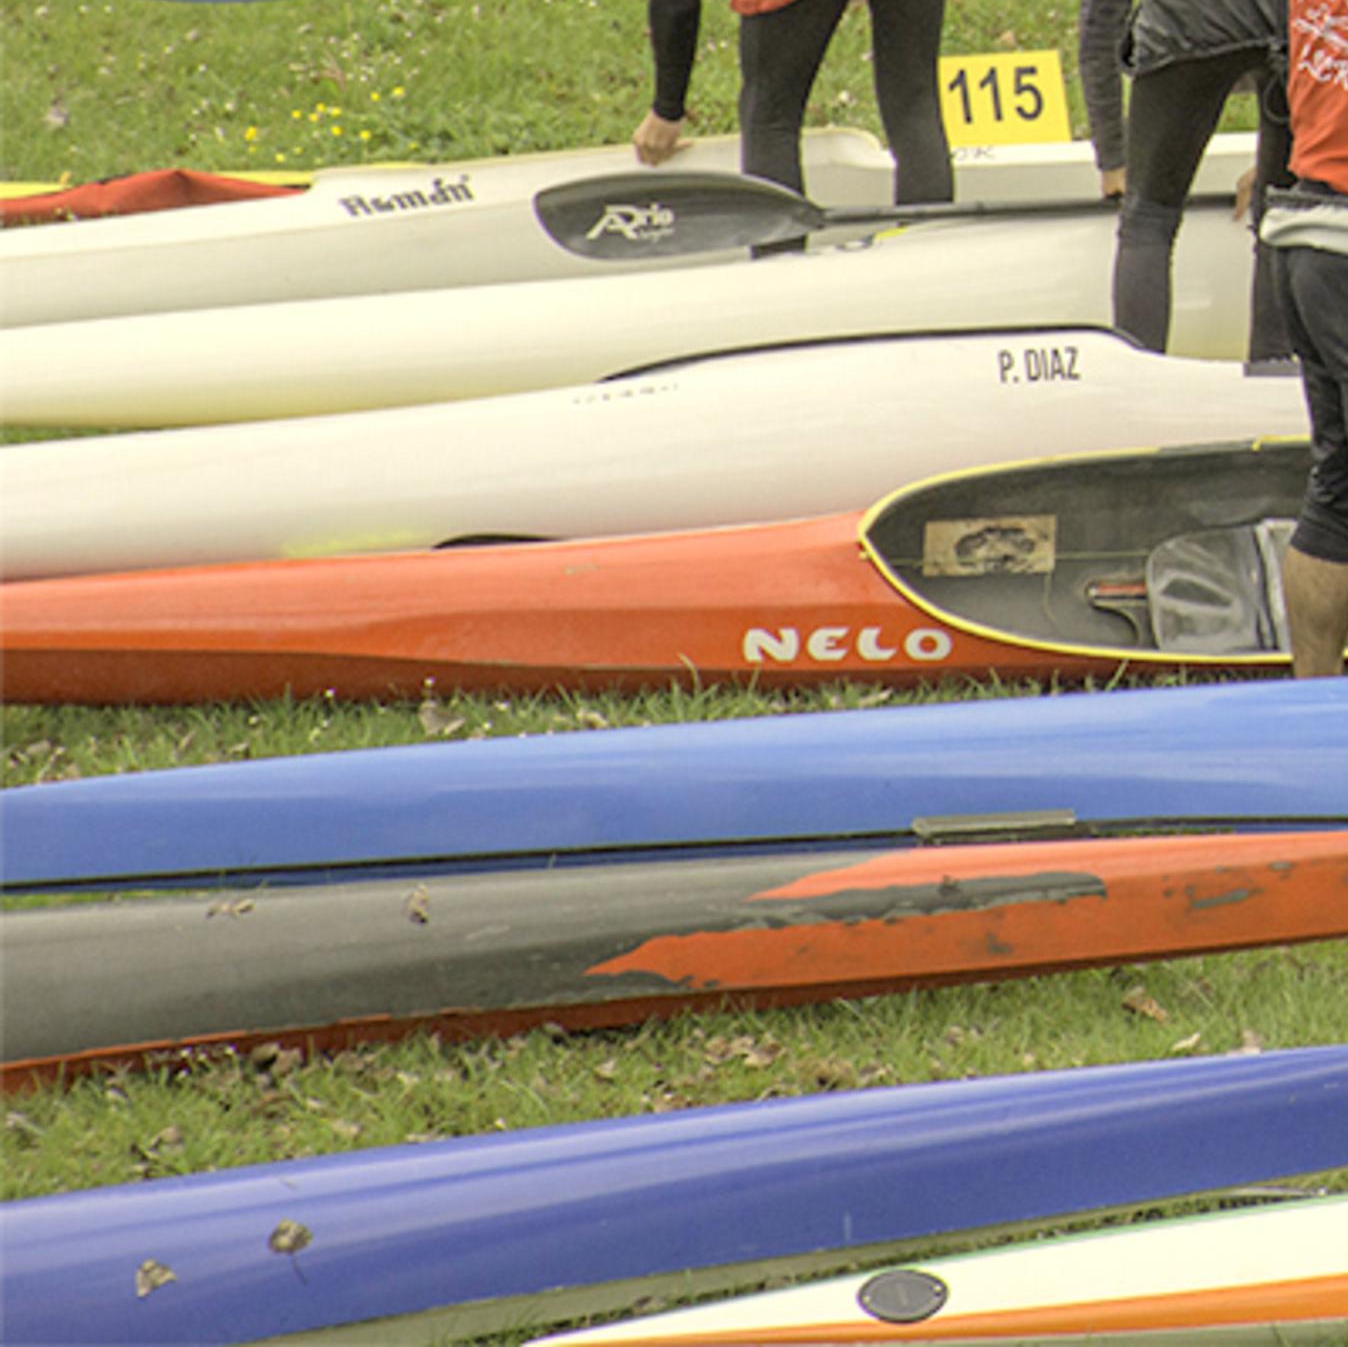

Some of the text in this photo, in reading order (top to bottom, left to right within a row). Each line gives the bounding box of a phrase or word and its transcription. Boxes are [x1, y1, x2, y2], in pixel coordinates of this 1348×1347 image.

[947, 65, 1044, 125] 115
[997, 344, 1083, 384] P. DIAZ
[742, 625, 953, 664] NELO
